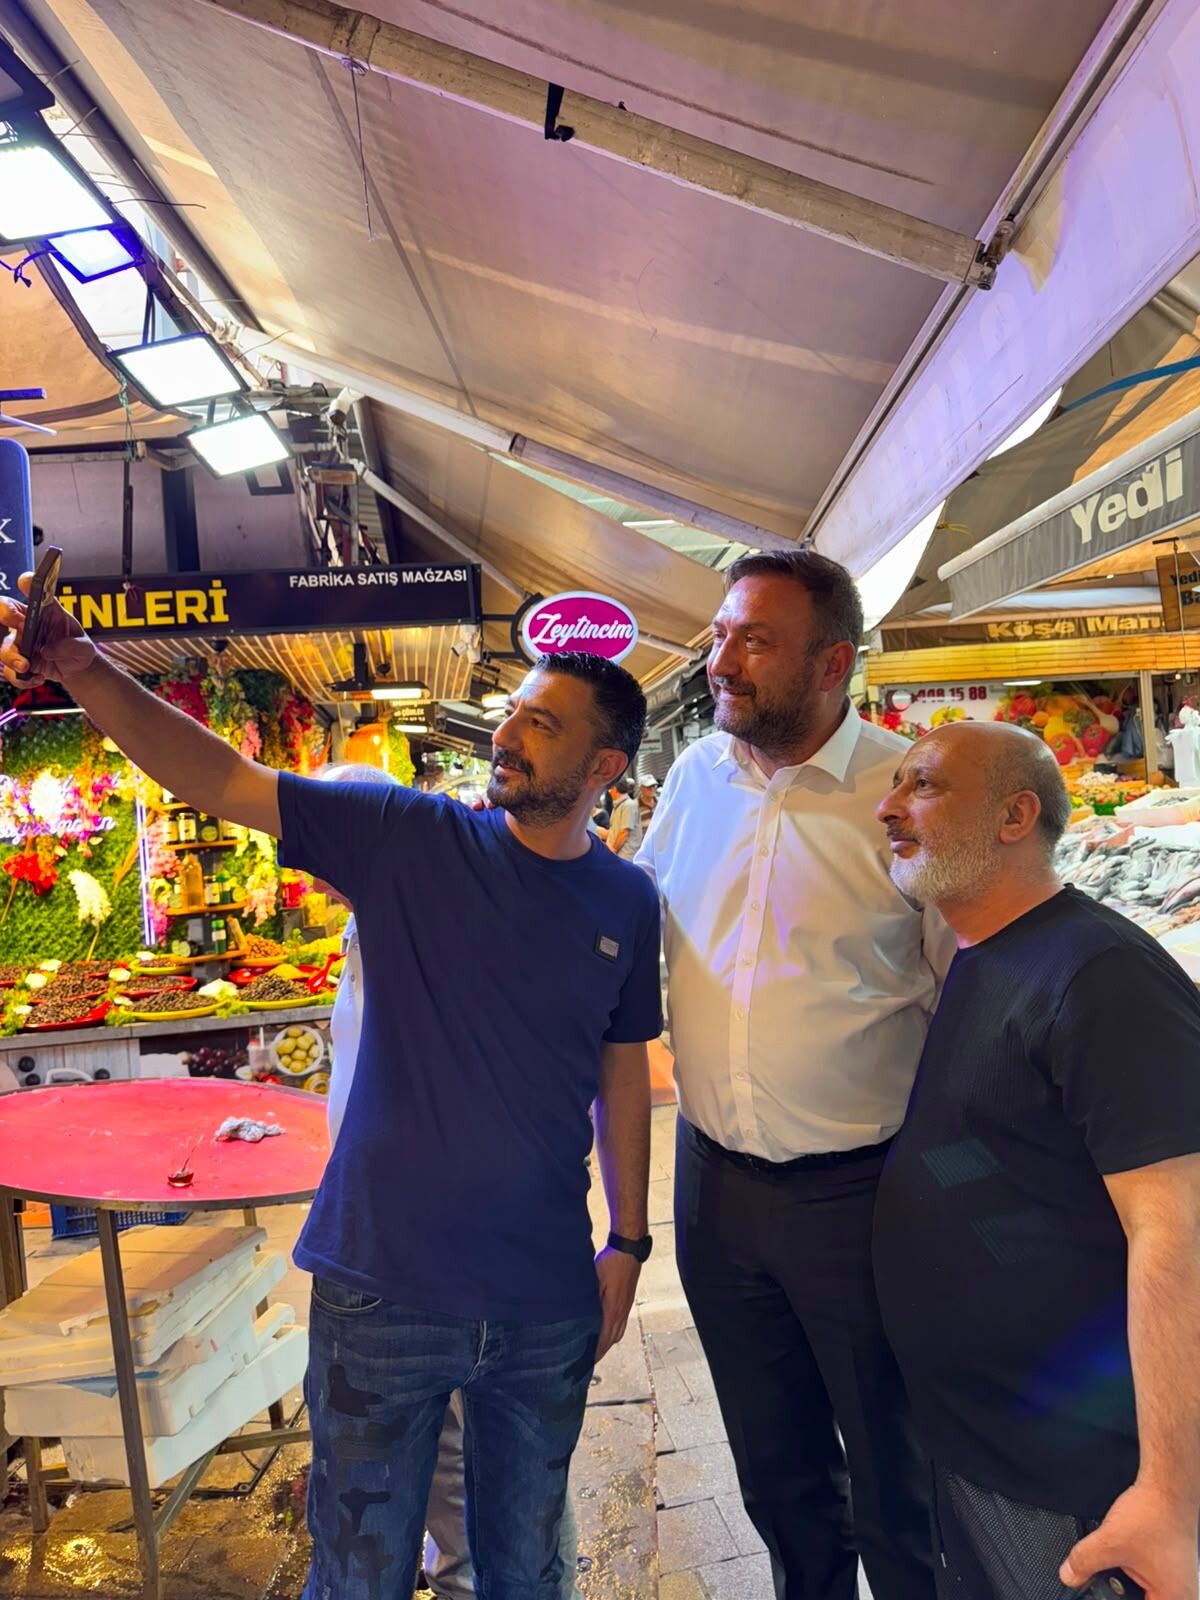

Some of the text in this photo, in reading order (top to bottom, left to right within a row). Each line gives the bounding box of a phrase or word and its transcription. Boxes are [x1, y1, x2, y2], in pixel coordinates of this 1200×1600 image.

[1070, 447, 1183, 544] Yedi
[289, 567, 467, 588] FABRİKA SATIŞ MAĞZASI
[1170, 570, 1200, 586] Yed
[531, 613, 635, 648] Zeytincim
[1086, 615, 1165, 633] Man
[968, 686, 987, 701] 88
